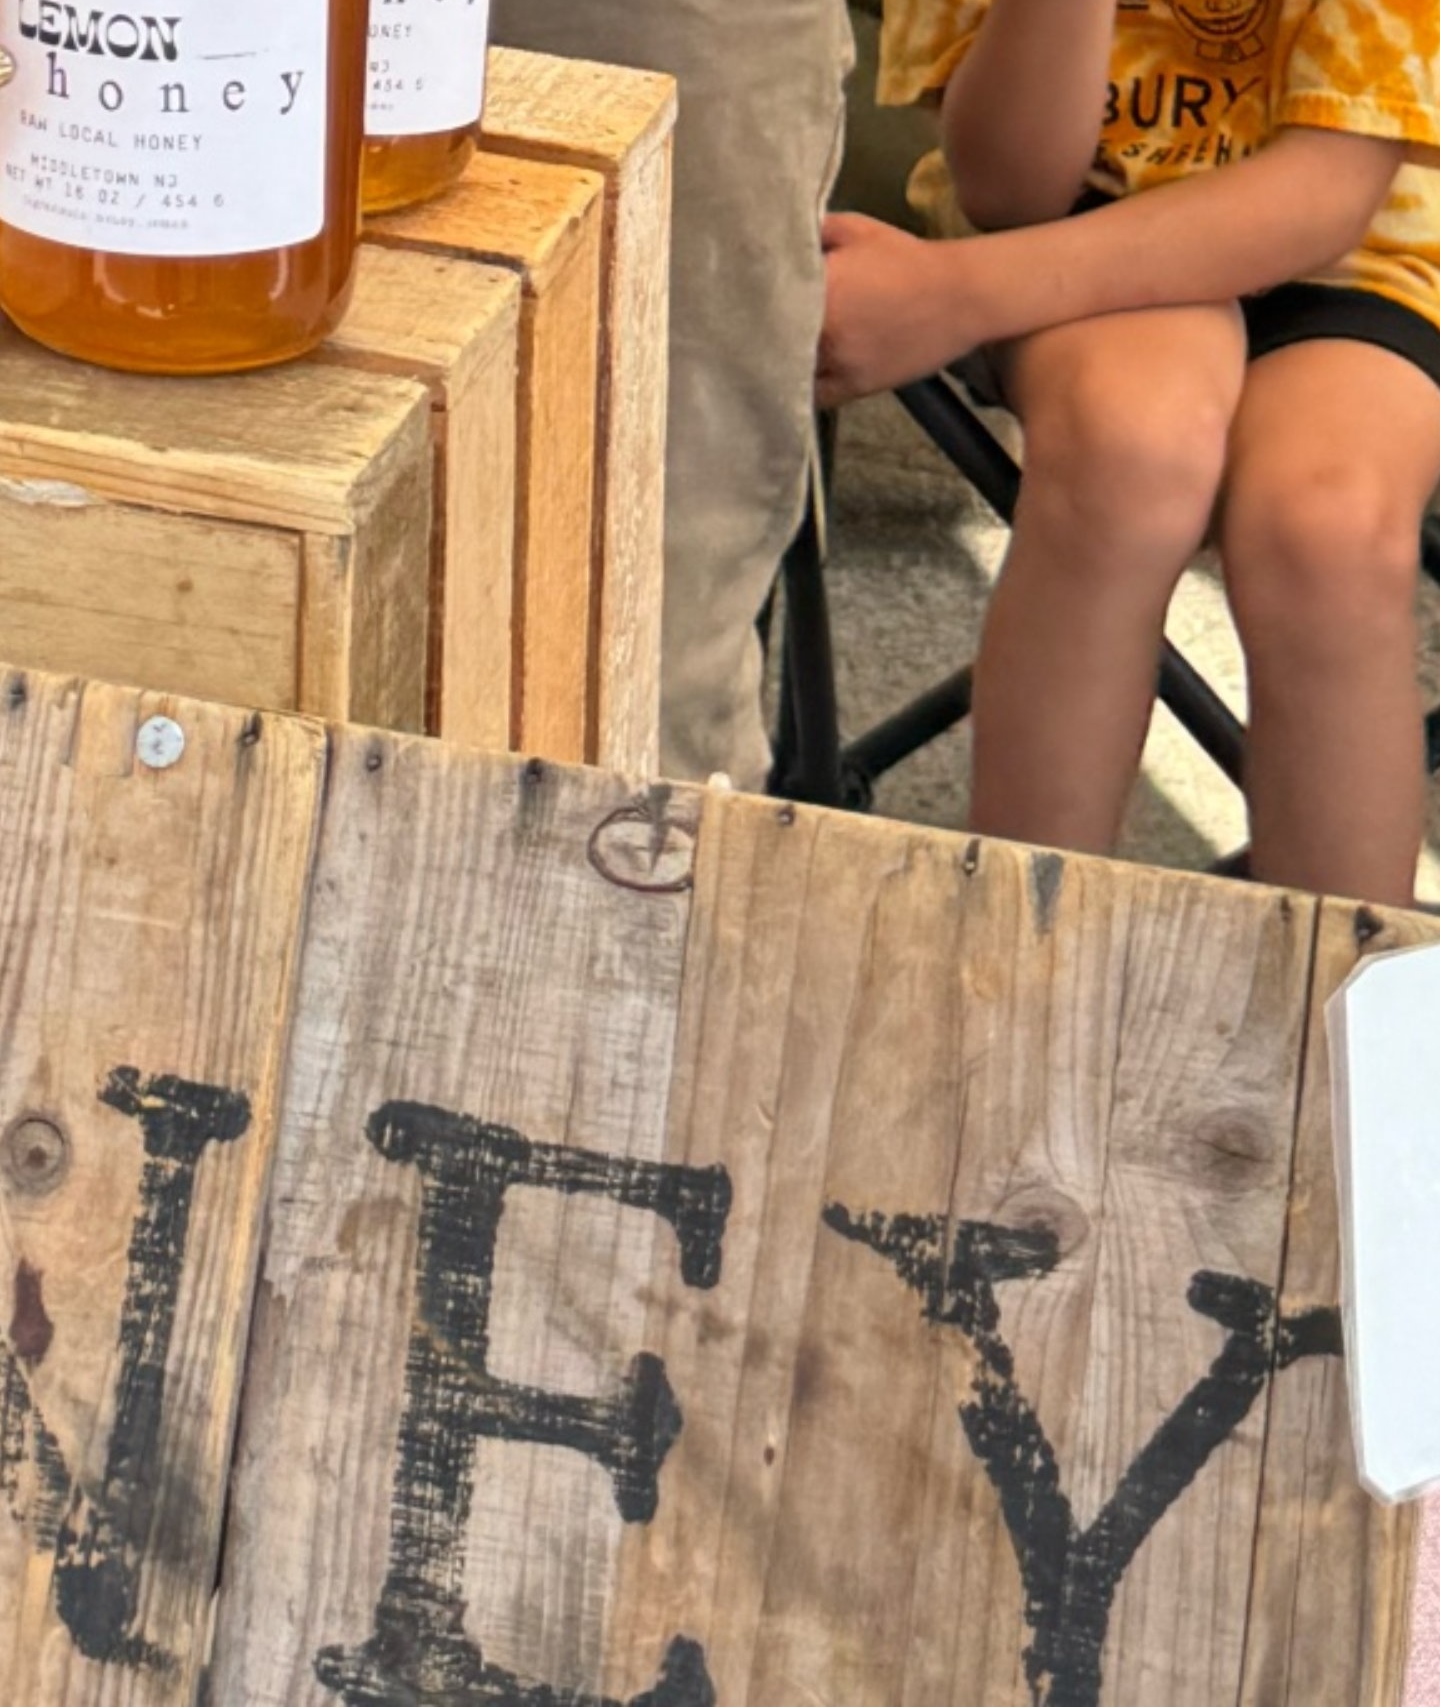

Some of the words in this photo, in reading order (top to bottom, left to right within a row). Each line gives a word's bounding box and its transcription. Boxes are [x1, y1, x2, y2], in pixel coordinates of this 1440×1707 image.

[47, 52, 305, 115] honey
[20, 109, 47, 130] RAW
[59, 123, 118, 147] LOCAL
[134, 133, 203, 151] HONEY
[6, 163, 26, 182] NET
[36, 175, 52, 190] WT
[65, 183, 84, 200] 16
[98, 189, 120, 205] OZ
[162, 194, 198, 208] 454
[30, 153, 140, 187] MIDDLETOWN
[154, 174, 178, 188] NJ
